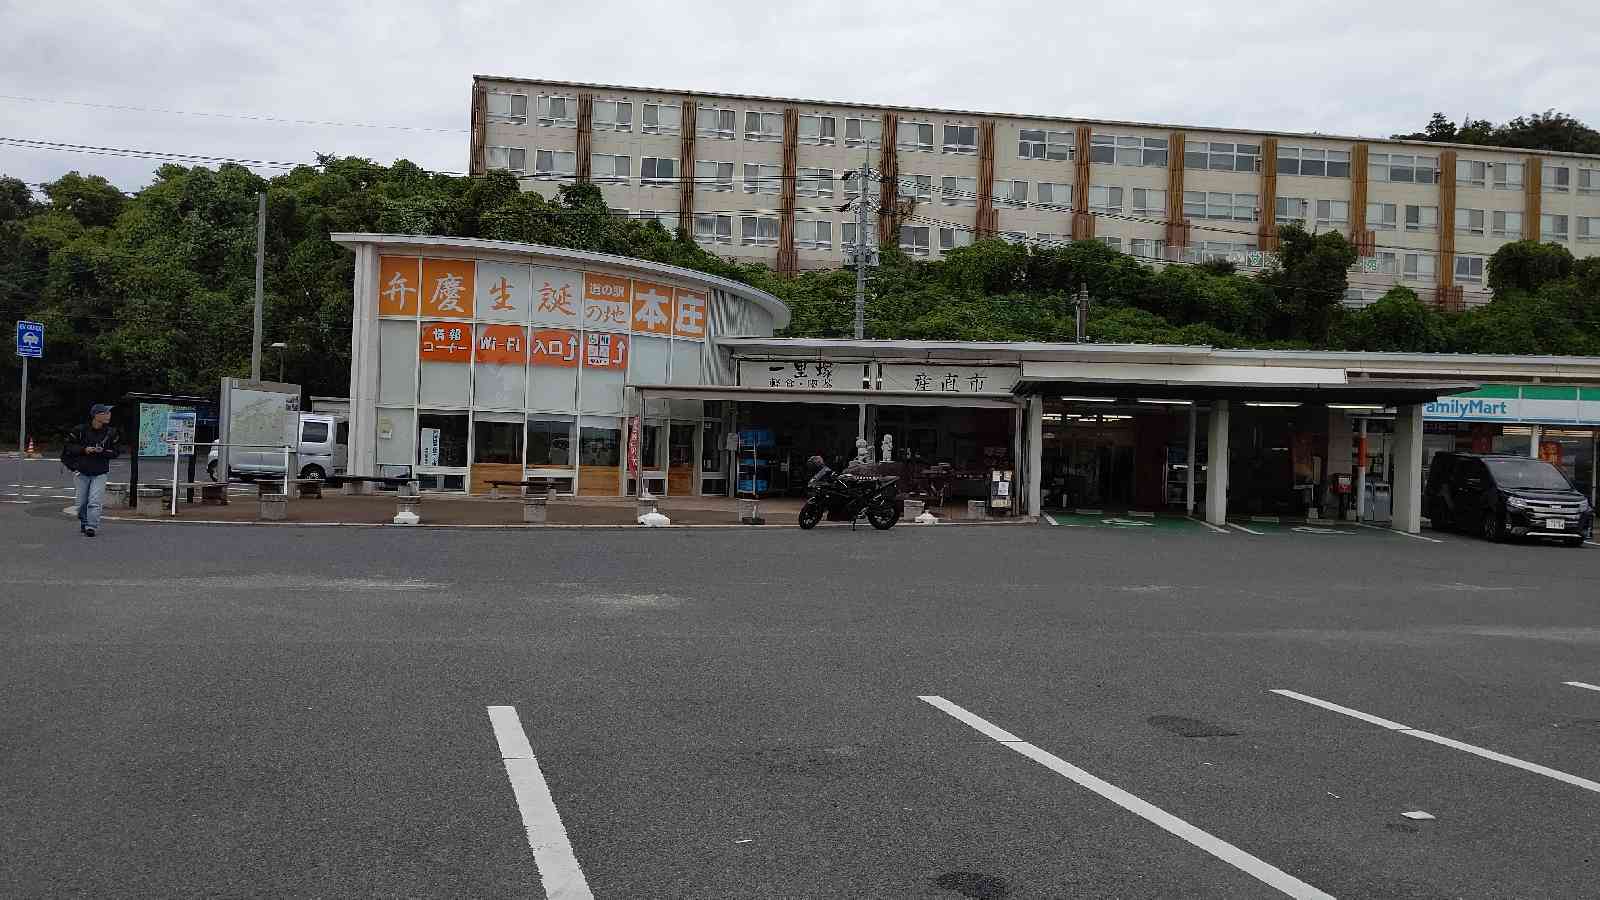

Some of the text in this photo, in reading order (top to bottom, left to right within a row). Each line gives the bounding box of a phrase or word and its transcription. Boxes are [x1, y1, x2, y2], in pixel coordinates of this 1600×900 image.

[635, 289, 705, 332] 本庄
[424, 341, 467, 353] コーナー
[480, 336, 521, 353] Wi-Fi
[536, 338, 563, 355] 入口
[914, 374, 987, 392] 産直市
